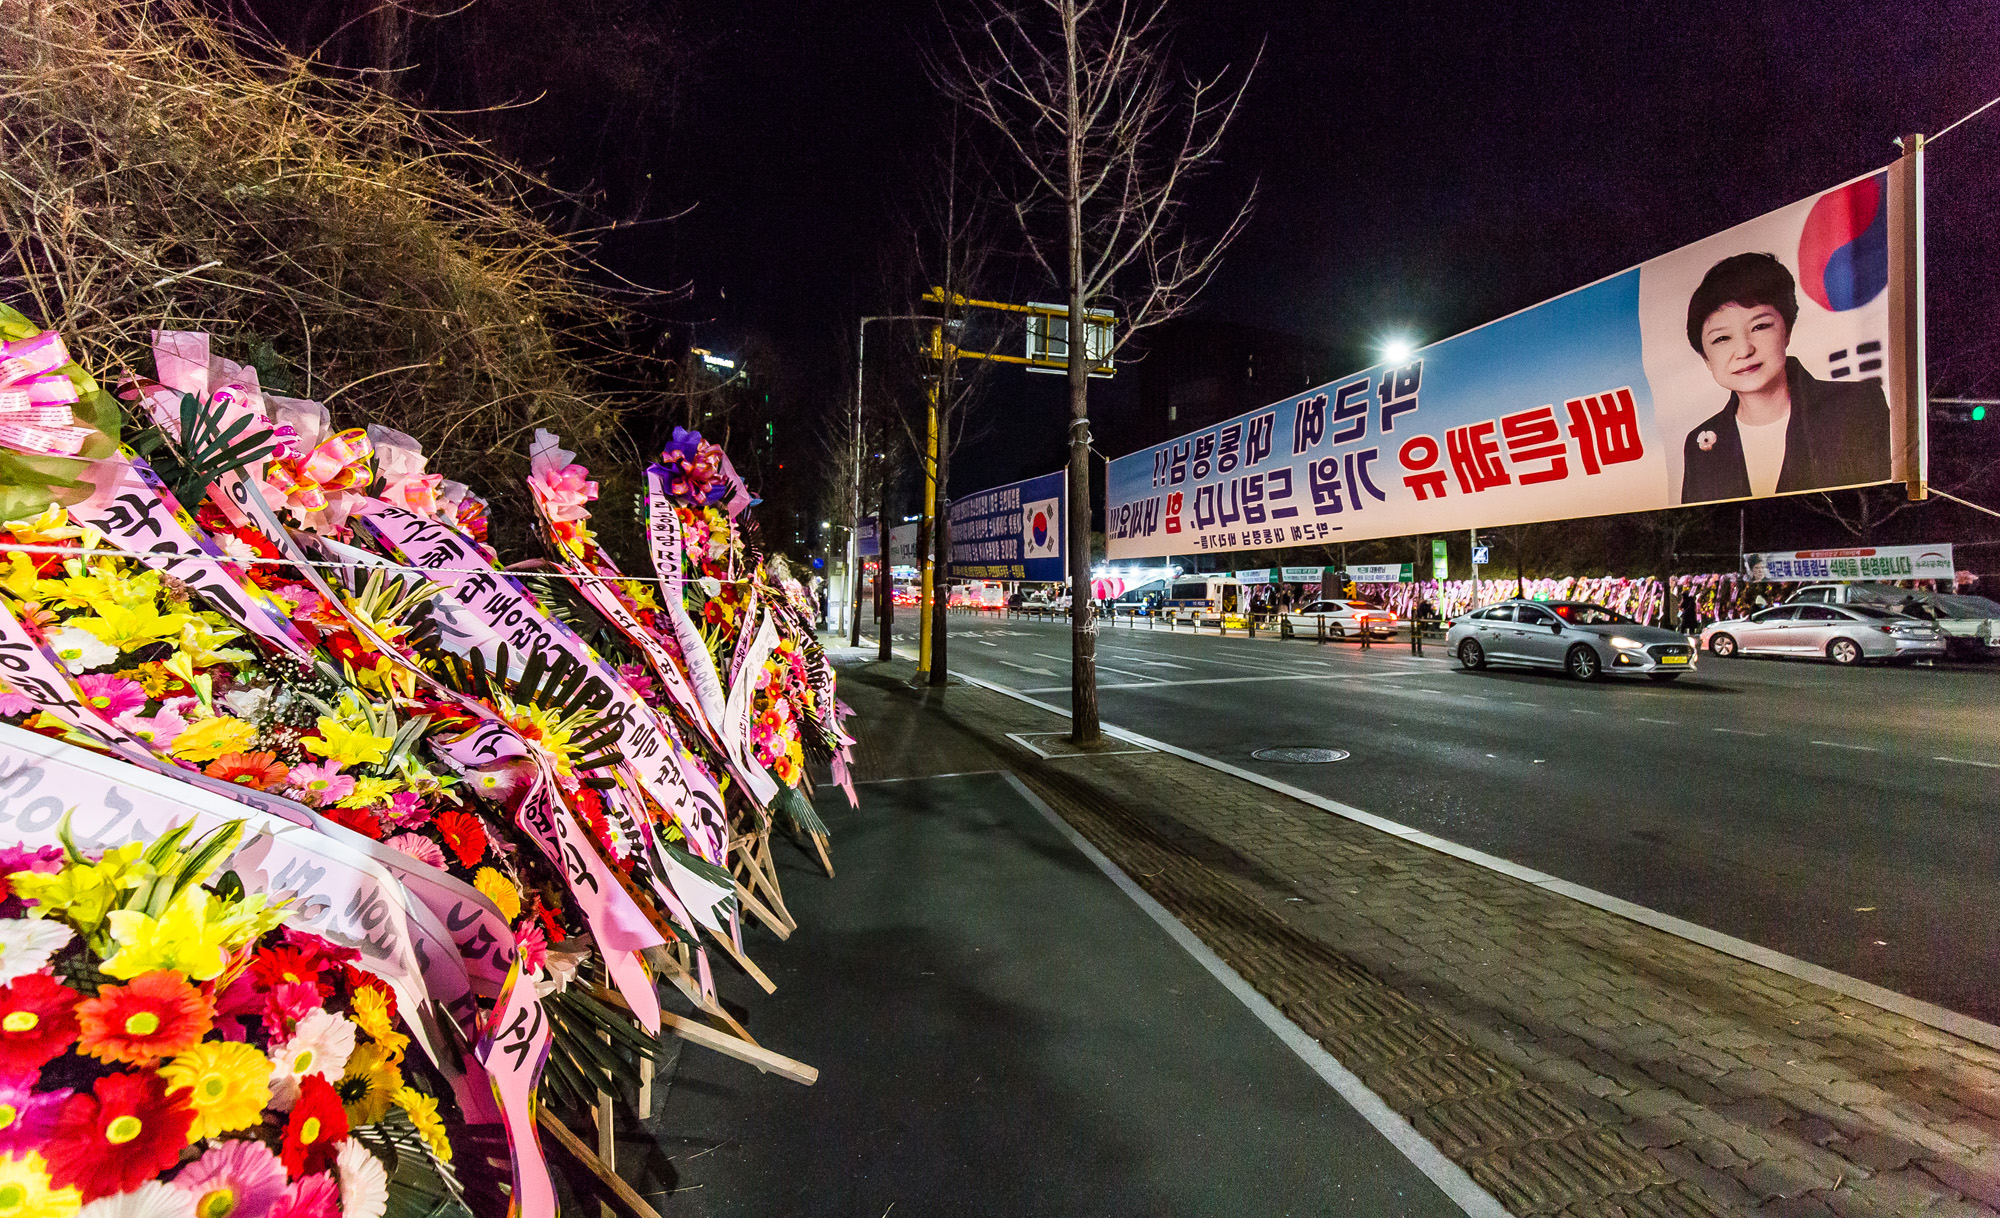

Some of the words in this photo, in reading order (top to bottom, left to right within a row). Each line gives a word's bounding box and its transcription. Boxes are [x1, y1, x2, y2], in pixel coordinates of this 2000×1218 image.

[376, 505, 466, 568] 박근혜
[1767, 559, 1792, 578] 박근혜
[1794, 558, 1828, 578] 대통령님
[1829, 557, 1857, 577] 석방을
[1860, 555, 1912, 576] 환영합니다
